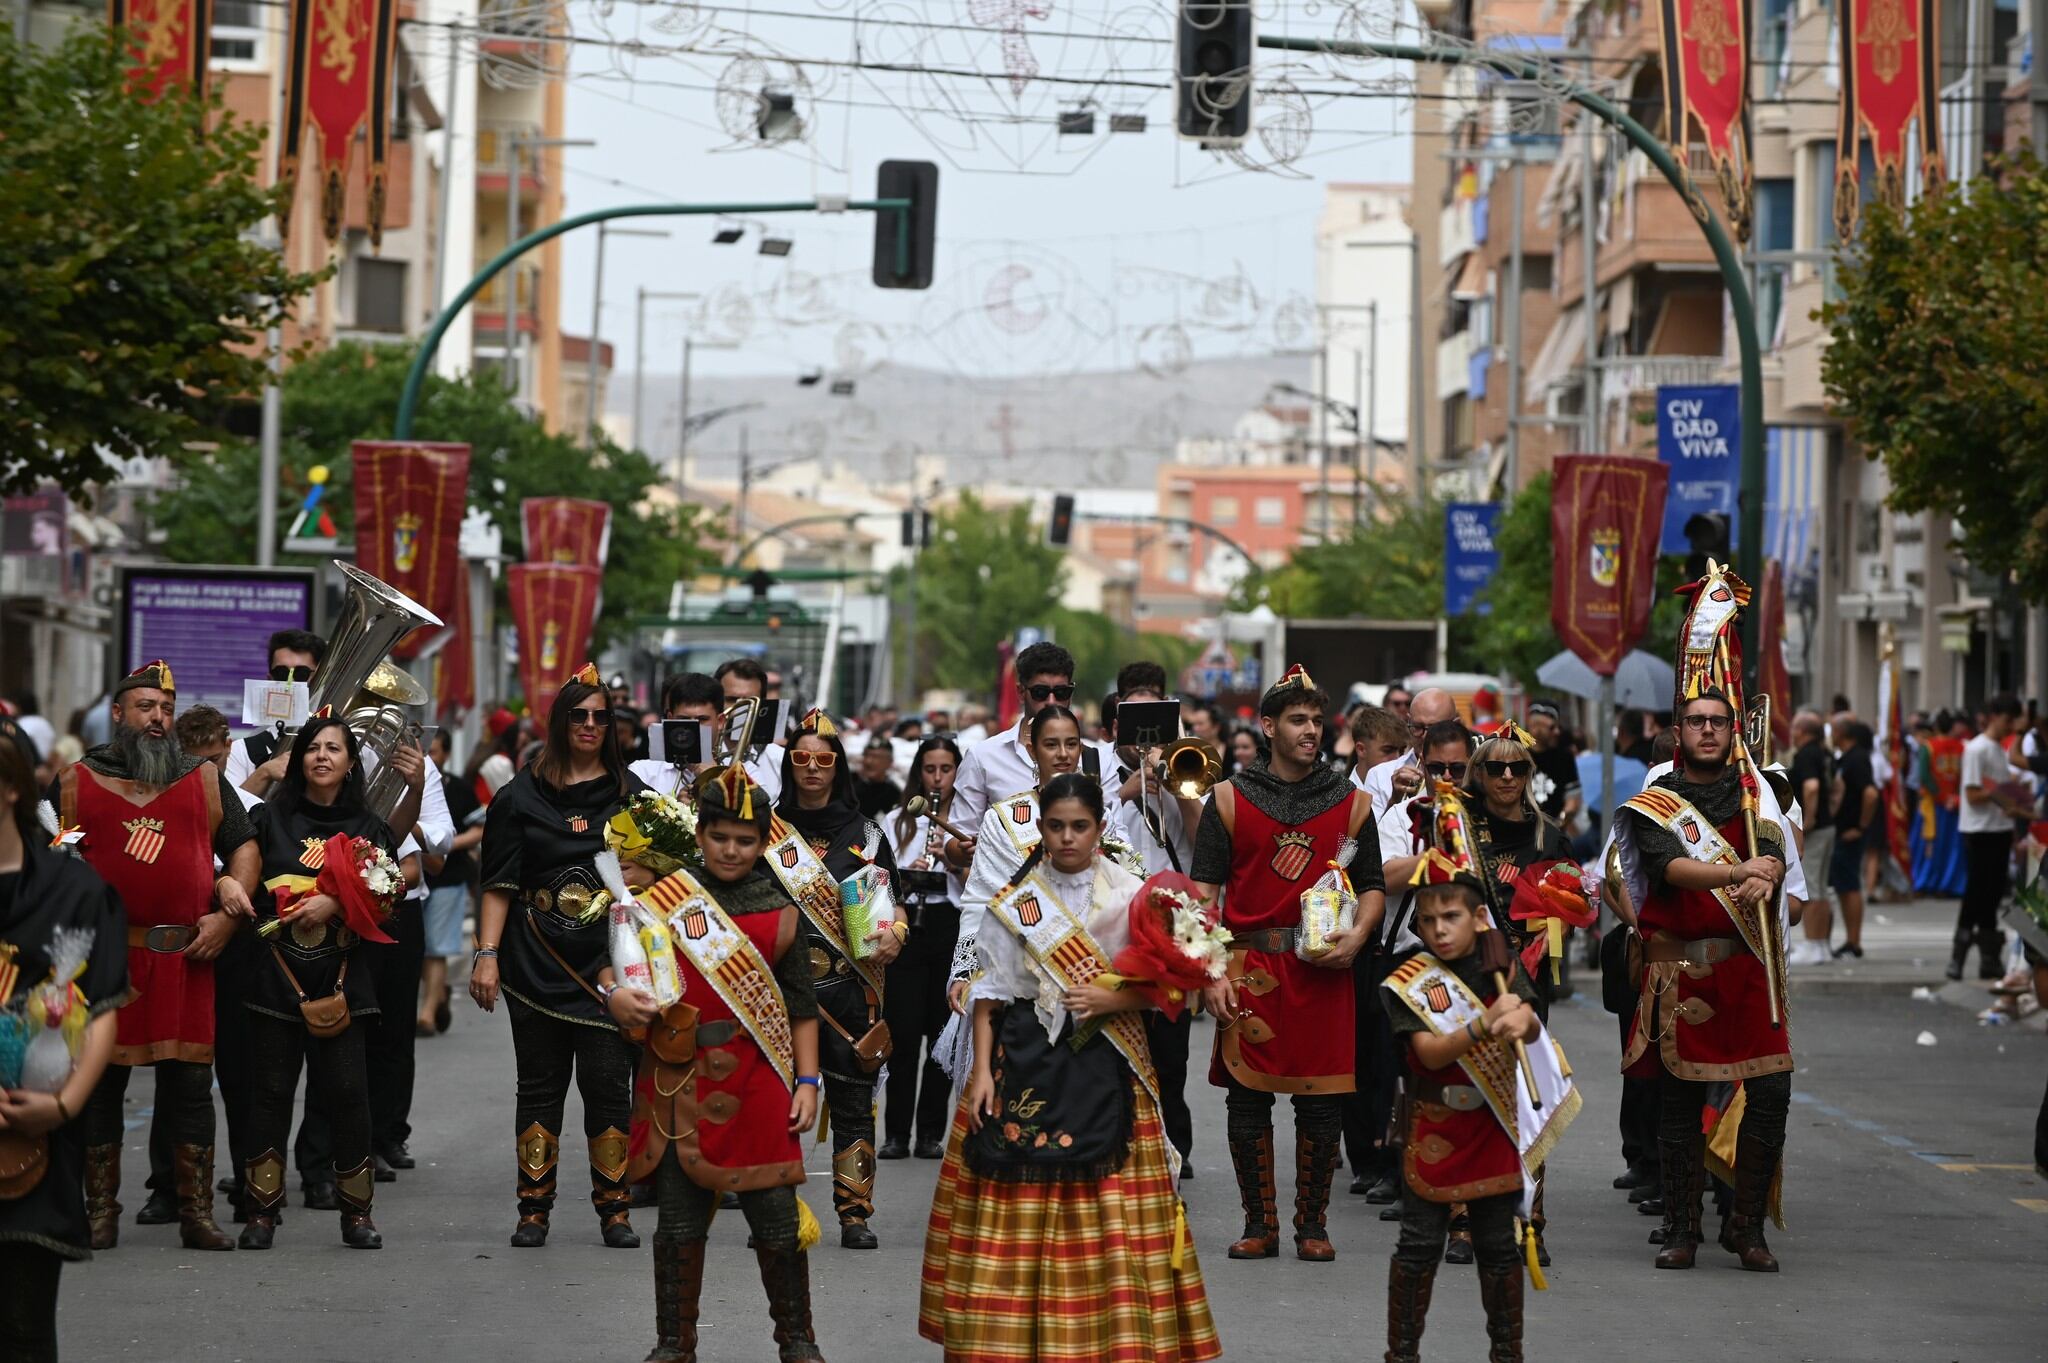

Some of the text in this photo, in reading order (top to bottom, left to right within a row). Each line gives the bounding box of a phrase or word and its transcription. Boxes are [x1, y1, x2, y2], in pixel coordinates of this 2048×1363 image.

[1667, 400, 1703, 419] CIV
[1672, 419, 1718, 438] DAD
[1679, 438, 1729, 458] VIVA
